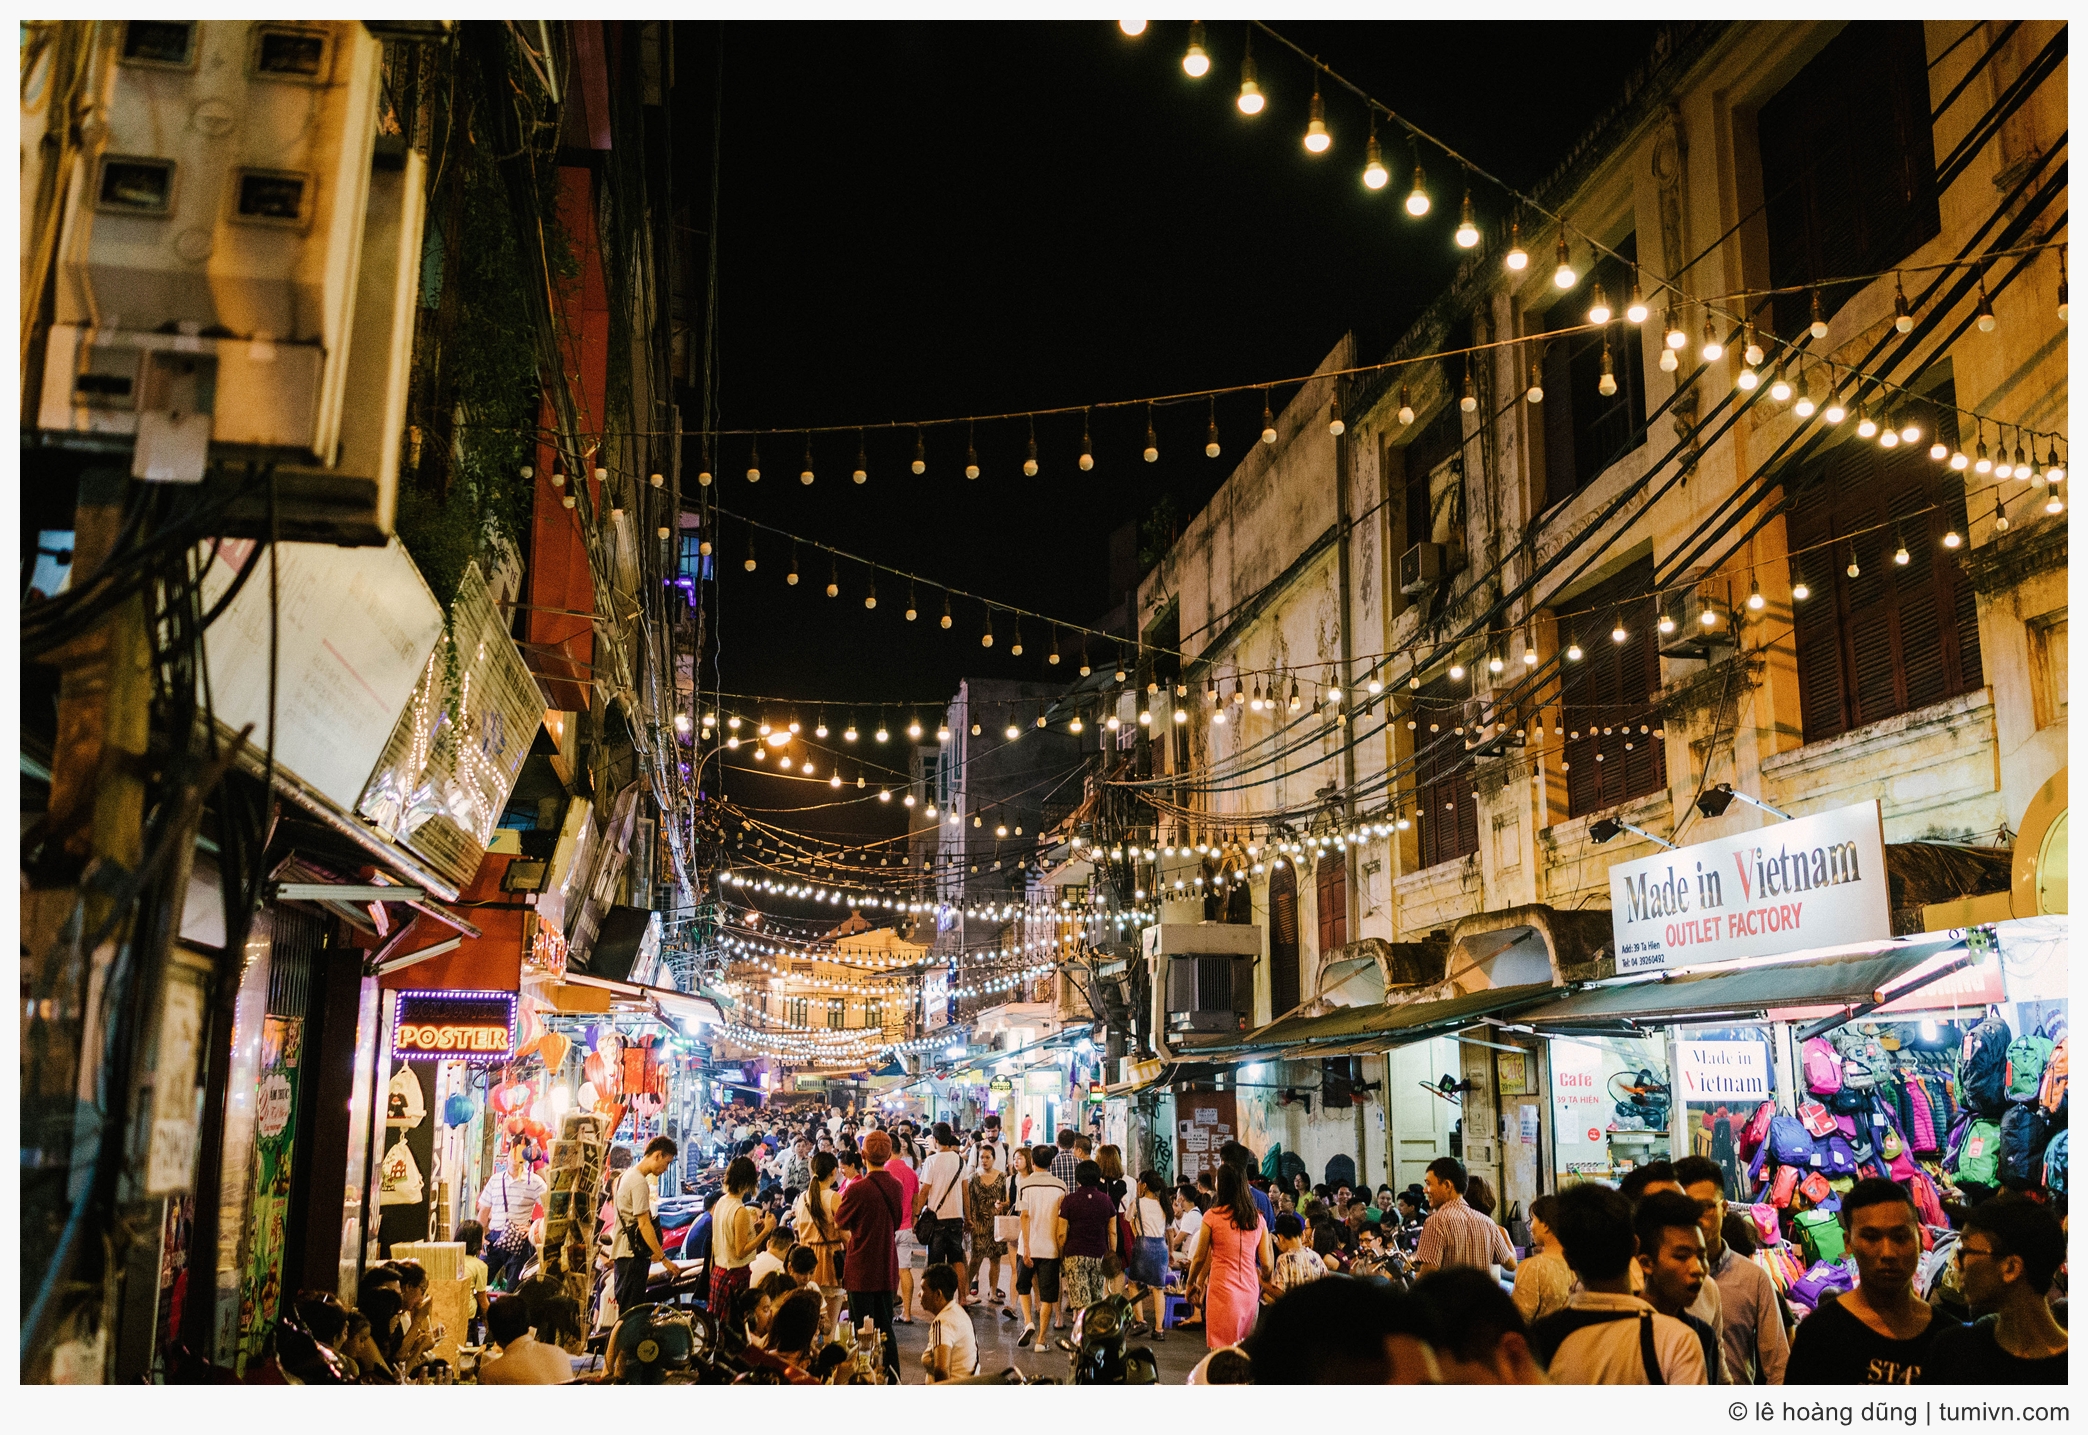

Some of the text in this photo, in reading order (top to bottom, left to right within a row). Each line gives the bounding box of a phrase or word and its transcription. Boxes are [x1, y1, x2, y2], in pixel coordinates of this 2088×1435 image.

[1624, 840, 1861, 923] Made in Vietnam
[1665, 902, 1802, 948] OUTLET FACTORY
[1631, 957, 1638, 966] 04
[396, 1026, 509, 1050] POSTER
[1692, 1048, 1751, 1066] Made in
[1560, 1070, 1592, 1087] Café
[1685, 1070, 1763, 1093] Vietnam
